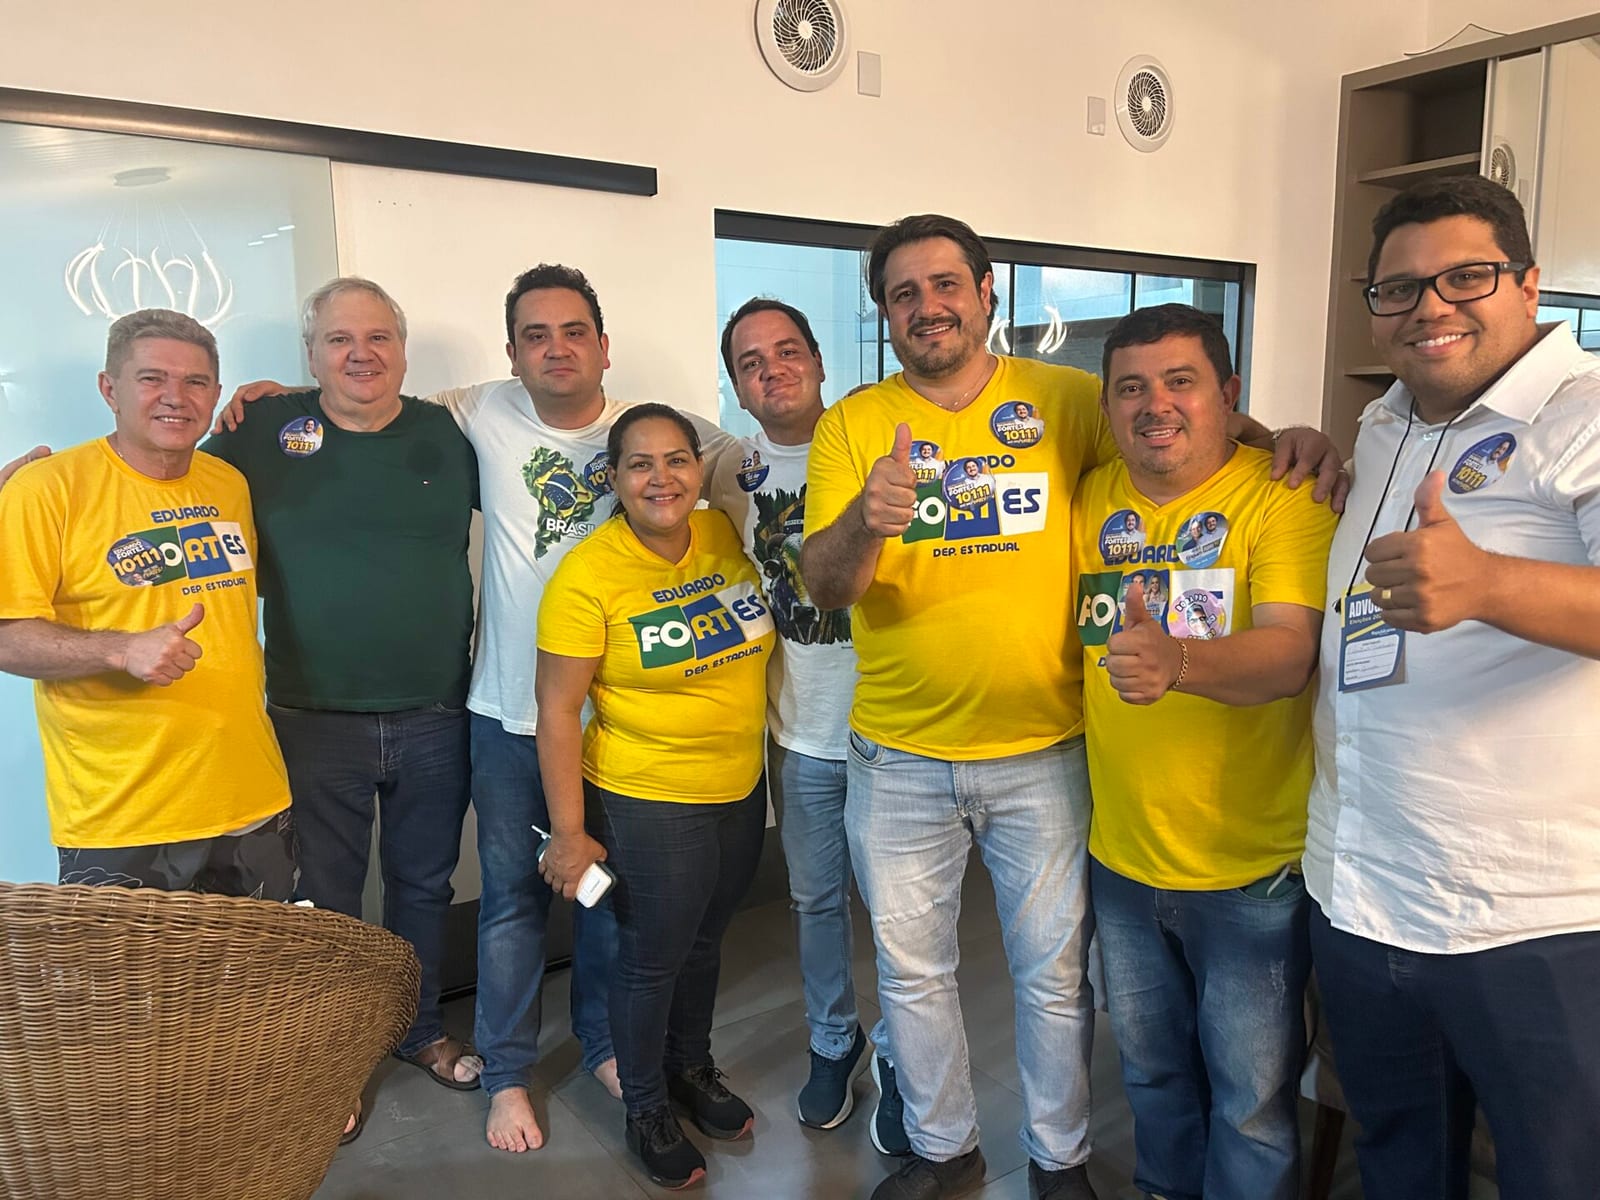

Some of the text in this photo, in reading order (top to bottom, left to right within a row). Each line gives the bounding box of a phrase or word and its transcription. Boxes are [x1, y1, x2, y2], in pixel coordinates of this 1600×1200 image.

[1004, 428, 1038, 441] 10111
[286, 441, 315, 451] 10111
[742, 458, 753, 469] 22
[912, 468, 936, 480] 111
[1456, 466, 1487, 488] 10111
[956, 484, 991, 505] 10111
[151, 505, 220, 523] EDUARDO
[909, 488, 1041, 526] OES
[159, 534, 247, 567] ORTES
[933, 542, 1020, 557] DEP. ESTADUAL
[1104, 544, 1180, 566] UARD
[1108, 543, 1139, 556] 10111
[113, 547, 162, 577] 10111
[182, 578, 247, 596] DEP. ESTADUAL
[652, 573, 726, 603] EDUARDO
[1349, 598, 1383, 618] ADVO
[640, 594, 767, 653] FORTES
[684, 645, 764, 678] DEP. ESTADUAL
